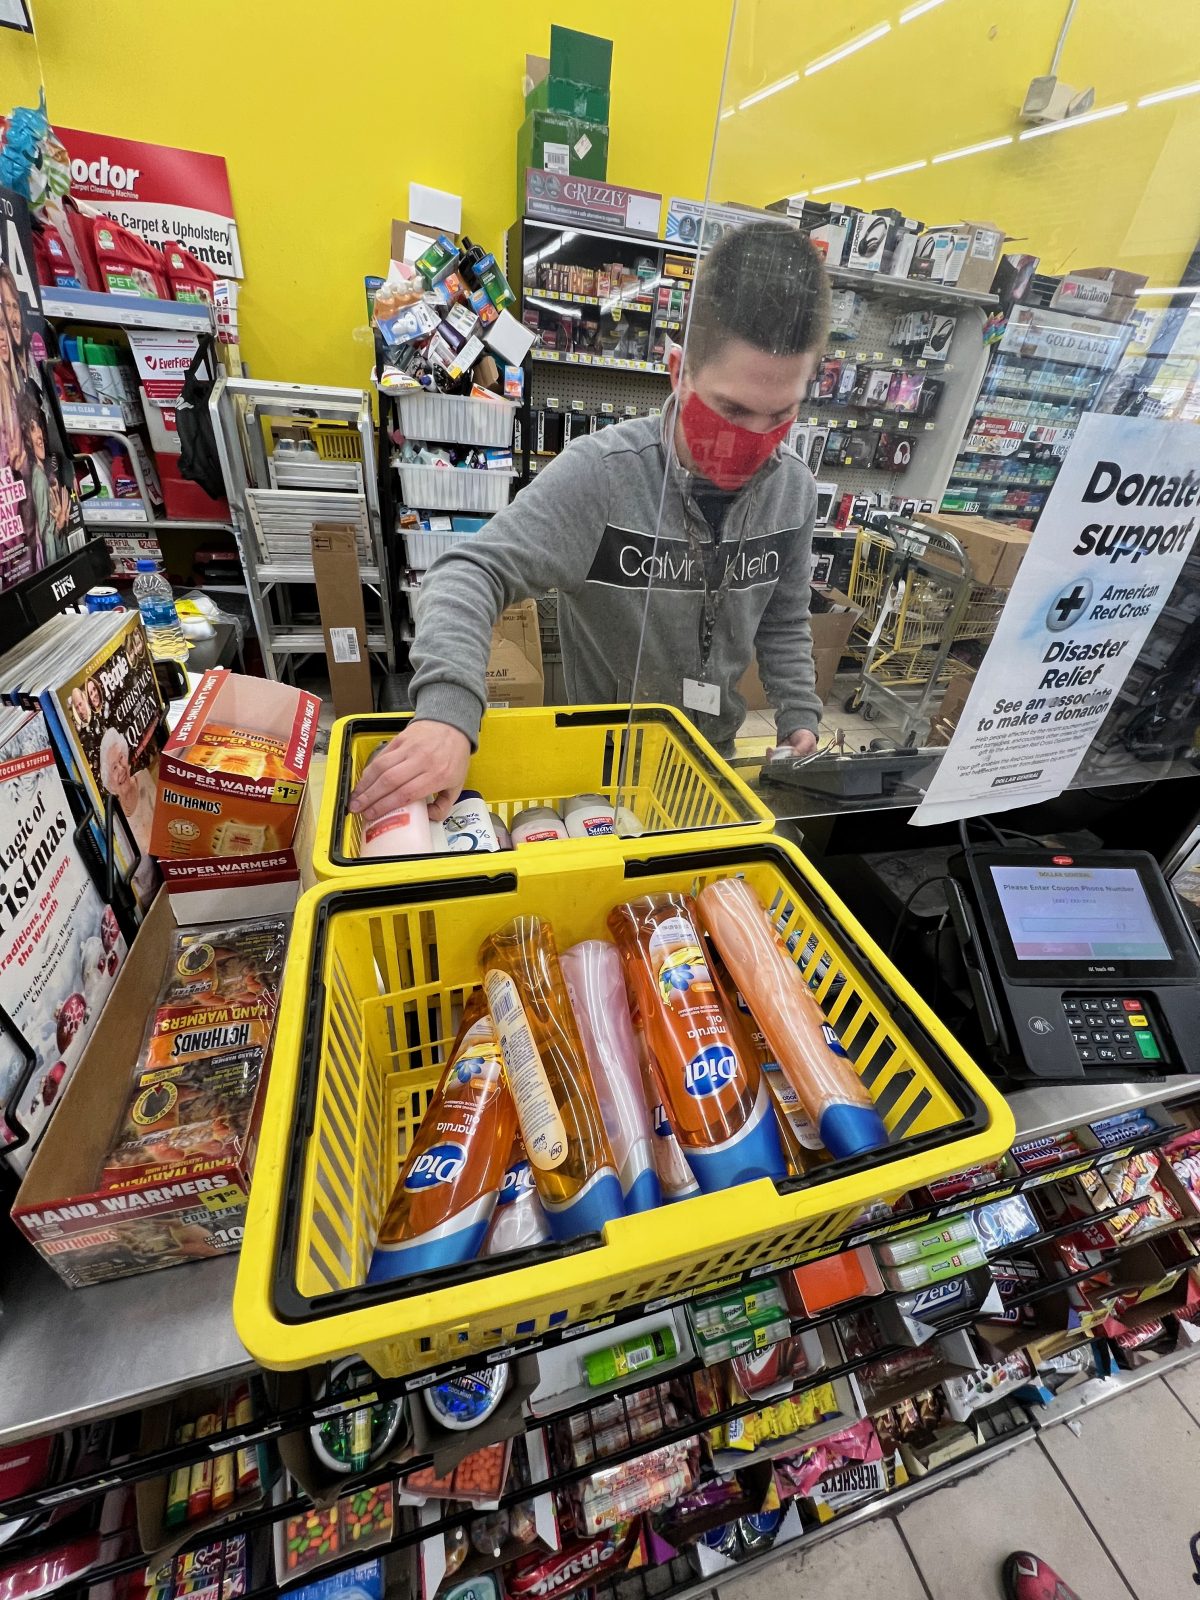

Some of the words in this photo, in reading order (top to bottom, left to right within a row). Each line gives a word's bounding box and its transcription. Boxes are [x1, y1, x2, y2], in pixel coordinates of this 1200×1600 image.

[90, 185, 115, 197] Cleaning
[115, 189, 139, 199] Machine
[563, 182, 629, 209] GRIZZLY
[121, 212, 159, 233] Carpet
[162, 218, 171, 234] &
[173, 221, 230, 245] Upholstery
[109, 277, 131, 288] PET
[1074, 283, 1110, 304] Marlboro
[1046, 333, 1077, 349] GOLD
[1081, 461, 1198, 507] Donate
[1073, 517, 1195, 563] support
[1100, 584, 1160, 601] American
[1089, 604, 1120, 621] Red
[1119, 602, 1151, 617] Cross
[1042, 639, 1129, 663] Disaster
[203, 675, 219, 693] LONG
[1038, 664, 1105, 690] Relief
[116, 666, 153, 722] CHRISTMAS
[190, 691, 211, 724] LASTING
[306, 699, 316, 717] HEAT
[977, 718, 994, 732] to
[996, 711, 1040, 729] make
[1041, 712, 1051, 724] a
[1054, 702, 1109, 721] donation
[993, 699, 1023, 715] See
[1026, 698, 1047, 711] an
[176, 721, 195, 742] HEAT
[203, 735, 248, 746] SUPER
[299, 714, 314, 748] LASTING
[26, 755, 50, 769] STUFFER
[294, 745, 307, 770] LONG
[167, 764, 217, 786] SUPER
[33, 791, 46, 823] of
[164, 789, 222, 815] HOTHANDS
[174, 823, 194, 836] 18
[169, 864, 215, 876] SUPER
[219, 857, 288, 873] WARMERS
[1051, 885, 1080, 893] Coupon
[0, 913, 42, 976] raditions,
[39, 892, 52, 912] the
[49, 857, 71, 893] History,
[17, 943, 34, 967] the
[32, 899, 59, 944] Warmth
[23, 986, 33, 1001] for
[32, 972, 43, 988] the
[41, 942, 60, 976] Season
[31, 957, 59, 1004] Christmas
[161, 1011, 228, 1031] WARMERS
[232, 1004, 269, 1018] HAND
[171, 1023, 250, 1057] HOTHANDS
[687, 1025, 727, 1039] marula
[686, 1056, 738, 1089] Dial
[437, 1122, 477, 1136] marula
[408, 1154, 463, 1183] Dial
[20, 1203, 98, 1229] HAND
[100, 1175, 229, 1211] WARMERS
[42, 1231, 121, 1255] HOTHANDS
[216, 1227, 244, 1243] 10
[747, 1300, 756, 1309] 28
[756, 1333, 766, 1342] 28
[821, 1464, 880, 1494] HERSHEY'S
